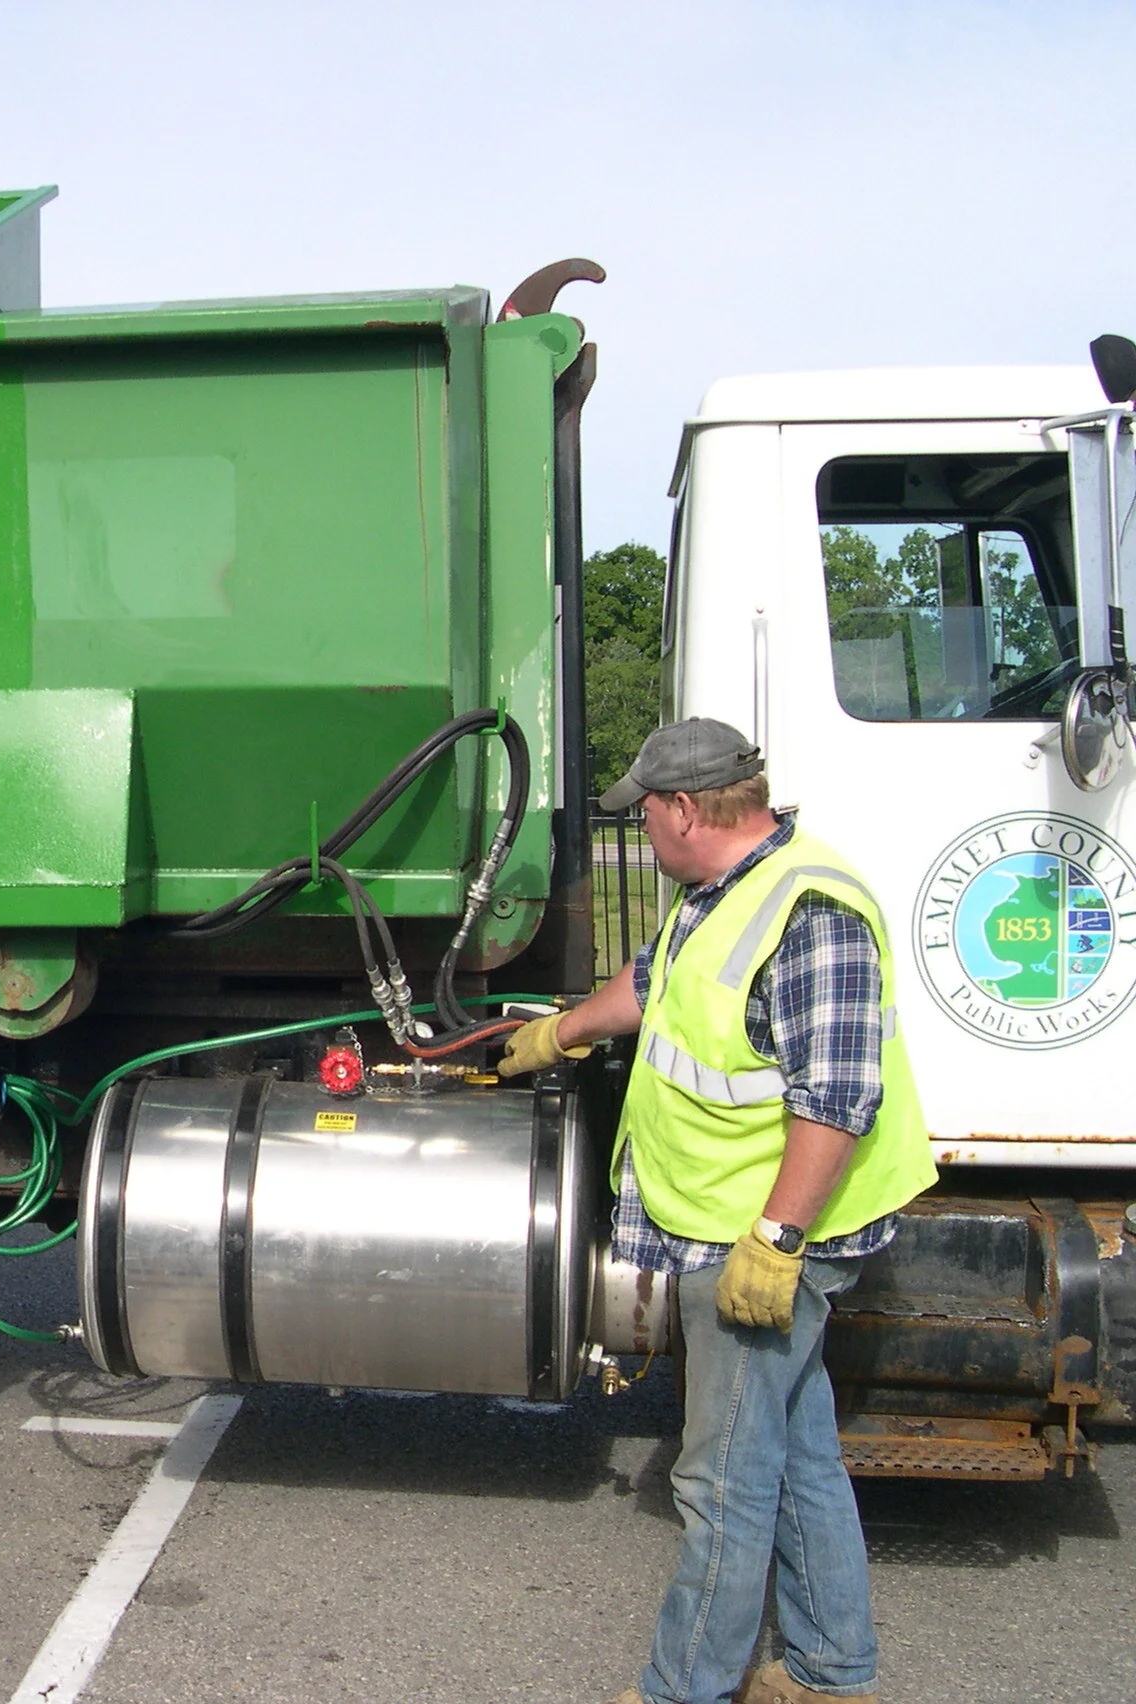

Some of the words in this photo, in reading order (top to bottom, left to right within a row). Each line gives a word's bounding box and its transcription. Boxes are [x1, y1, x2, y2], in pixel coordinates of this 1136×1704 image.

[925, 828, 1008, 950] EMMET
[996, 917, 1052, 942] 1853
[951, 984, 1028, 1037] Public
[1036, 988, 1118, 1036] Works
